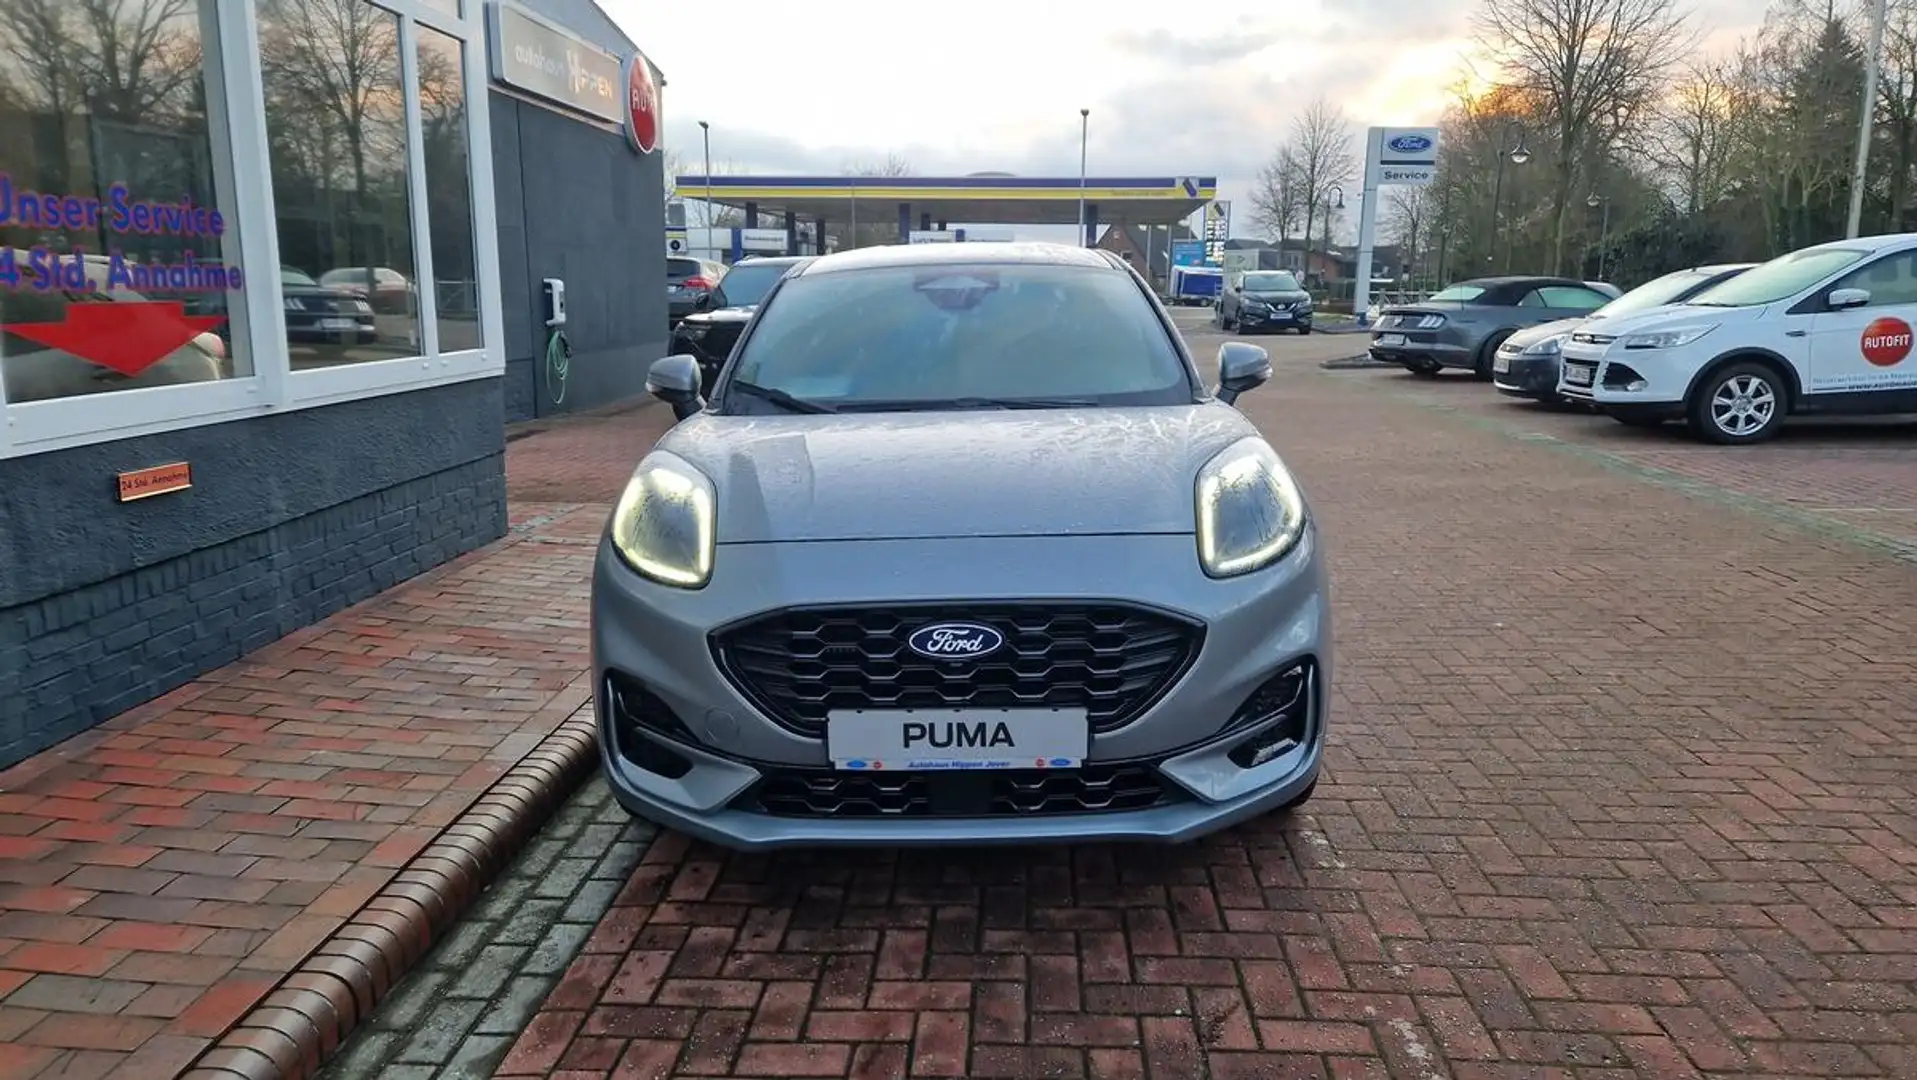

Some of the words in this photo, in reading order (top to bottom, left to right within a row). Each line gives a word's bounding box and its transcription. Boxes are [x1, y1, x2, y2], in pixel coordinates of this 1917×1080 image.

[1384, 171, 1429, 180] Service
[108, 181, 226, 236] Service
[28, 246, 98, 292] Std.
[107, 248, 244, 292] Annahme
[1864, 333, 1911, 349] AUTOFIT
[927, 628, 983, 652] Ford
[903, 722, 1015, 748] PUMA
